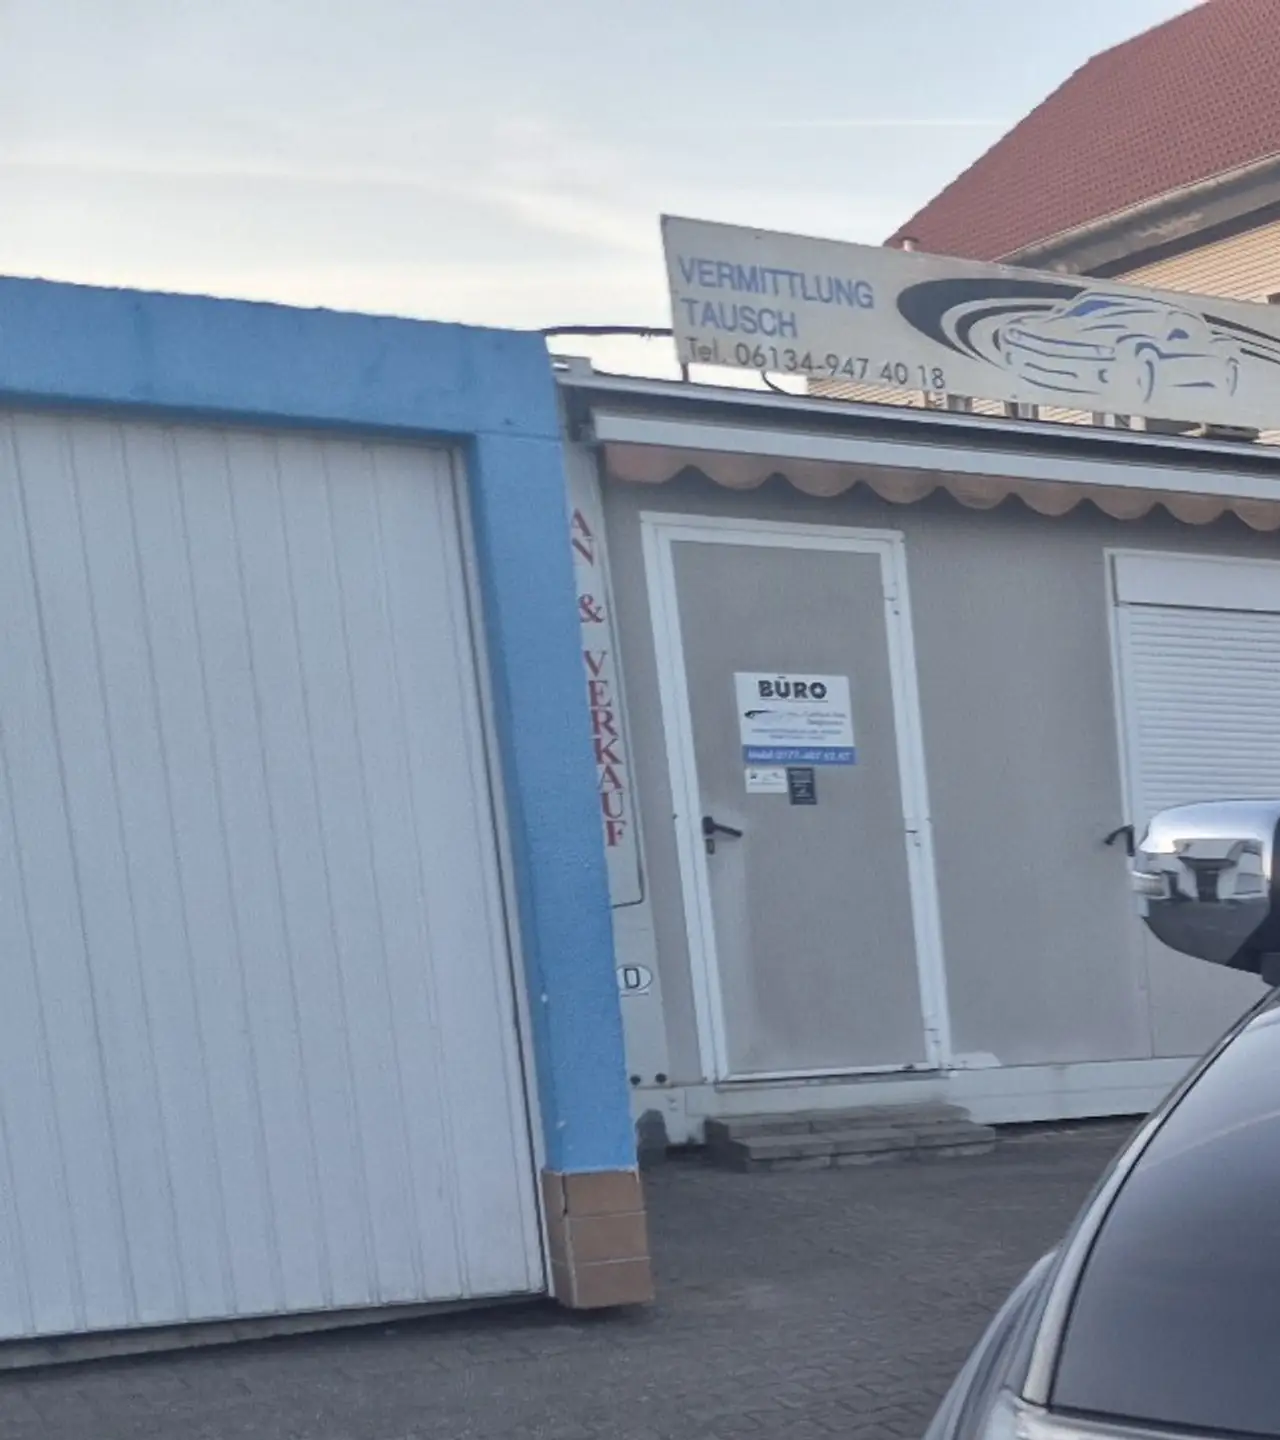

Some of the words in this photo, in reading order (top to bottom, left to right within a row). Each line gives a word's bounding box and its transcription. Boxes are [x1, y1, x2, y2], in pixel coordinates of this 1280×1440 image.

[678, 256, 874, 309] VERMITTLUNG
[680, 297, 798, 338] TAUSCH
[685, 336, 728, 364] Tel.
[735, 342, 870, 377] 06134-947
[880, 361, 909, 386] 40
[918, 365, 946, 390] 18
[578, 593, 606, 624] &
[757, 675, 828, 700] BÜRO
[583, 649, 627, 848] VERKAUF
